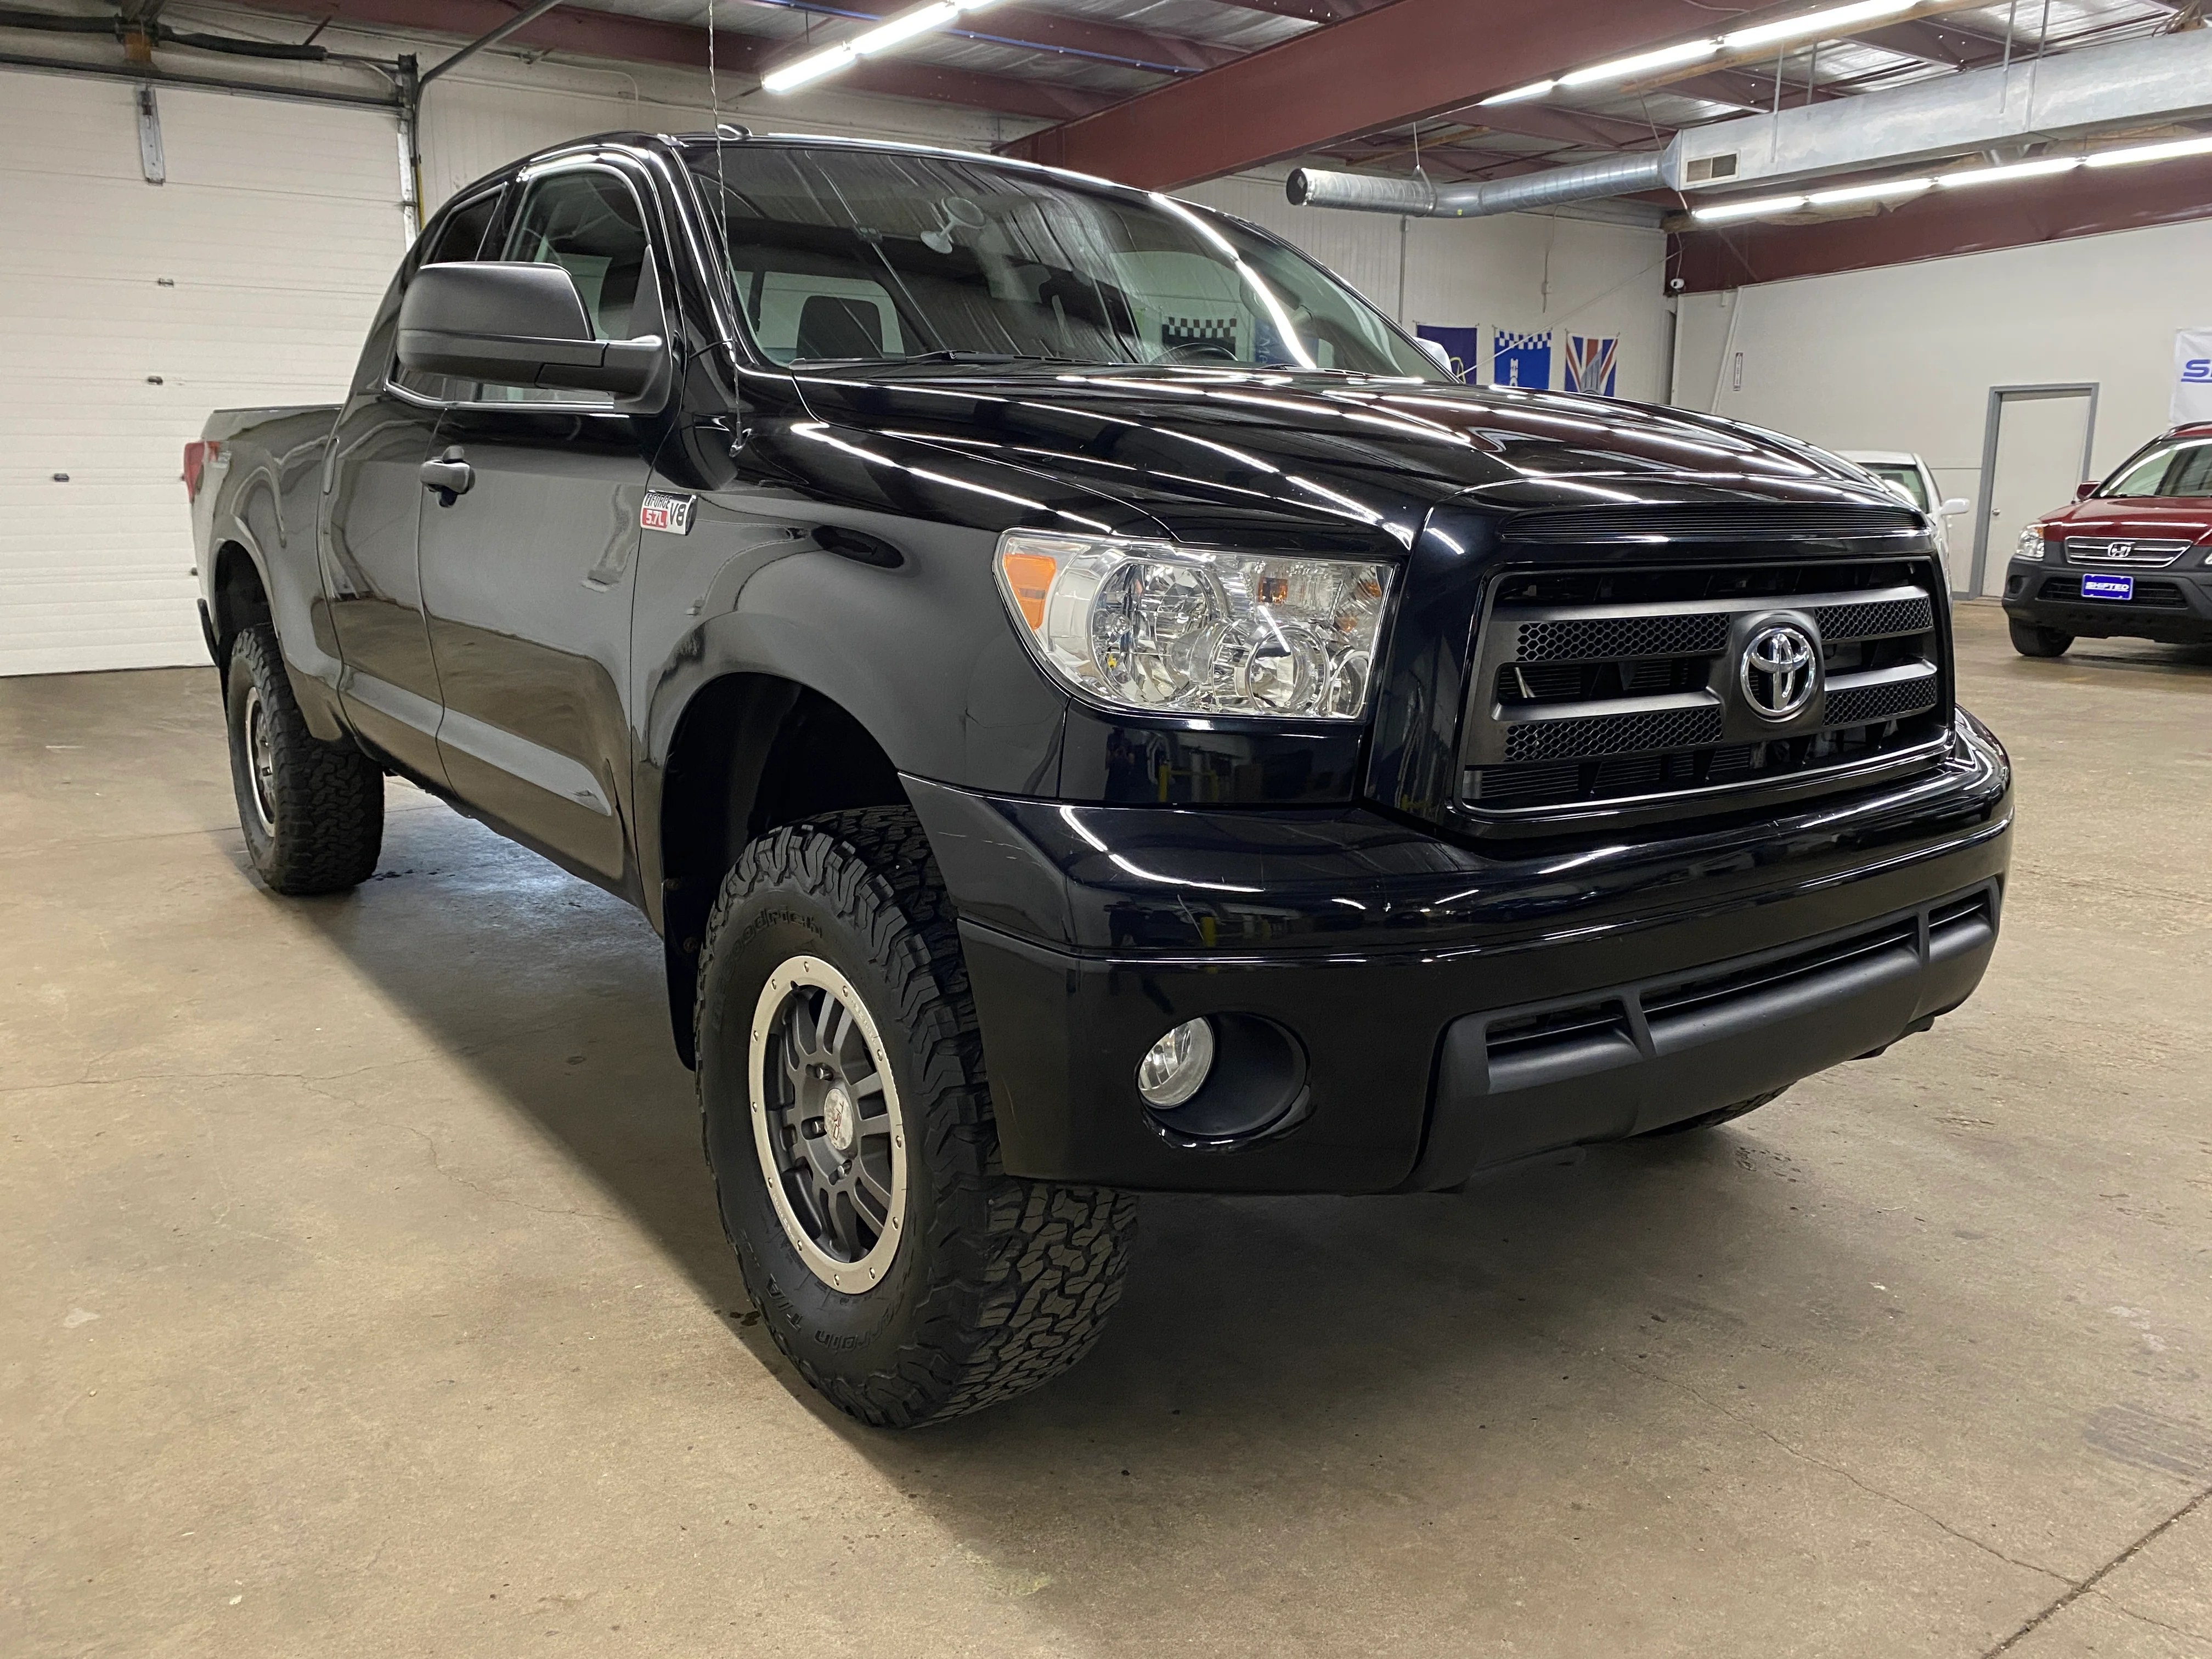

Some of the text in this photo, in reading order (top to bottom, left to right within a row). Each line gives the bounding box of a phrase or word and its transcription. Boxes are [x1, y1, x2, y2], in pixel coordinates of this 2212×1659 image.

[2183, 359, 2212, 377] S
[670, 503, 686, 527] V8
[833, 1101, 844, 1141] TRD
